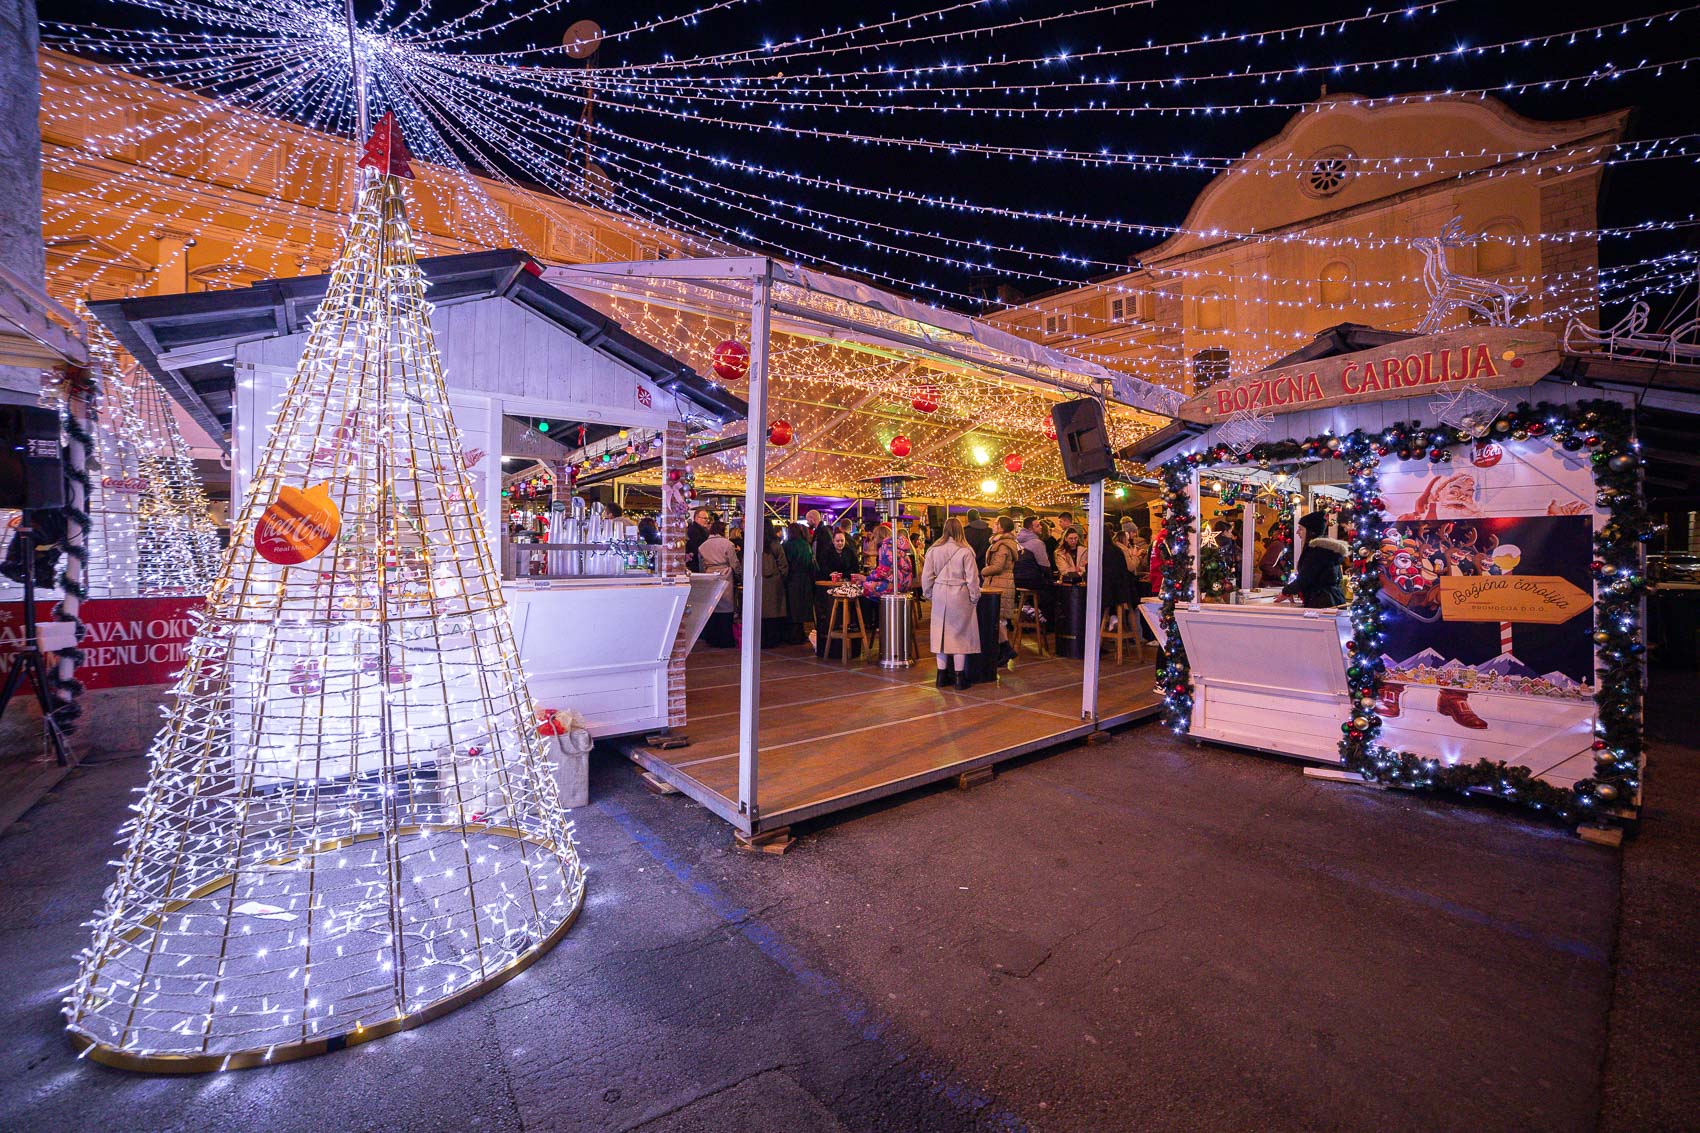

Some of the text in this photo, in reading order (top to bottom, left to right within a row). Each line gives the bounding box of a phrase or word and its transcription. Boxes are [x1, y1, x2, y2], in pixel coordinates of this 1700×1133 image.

[1216, 343, 1499, 415] BOŽIĆNA ČAROLIJA
[260, 508, 332, 544] Coca-Cola
[274, 545, 290, 553] Real
[1452, 578, 1569, 609] Božićna čarolija
